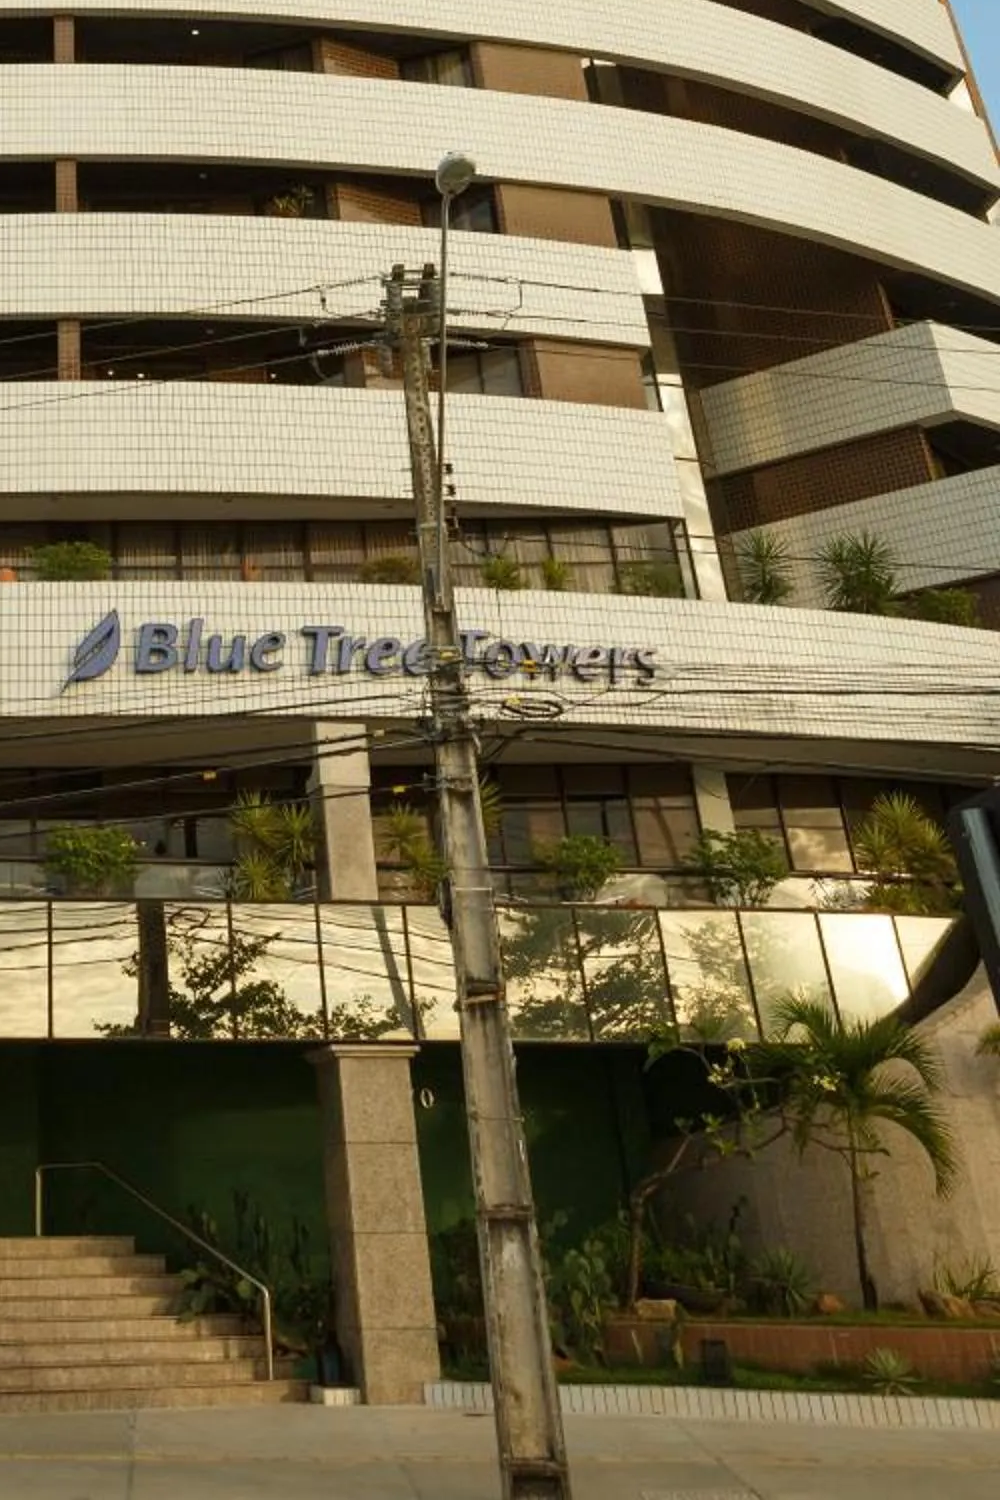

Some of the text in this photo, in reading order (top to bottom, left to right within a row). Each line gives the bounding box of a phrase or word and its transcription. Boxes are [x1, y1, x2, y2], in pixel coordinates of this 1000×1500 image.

[134, 617, 658, 686] Blue Tree Towers
